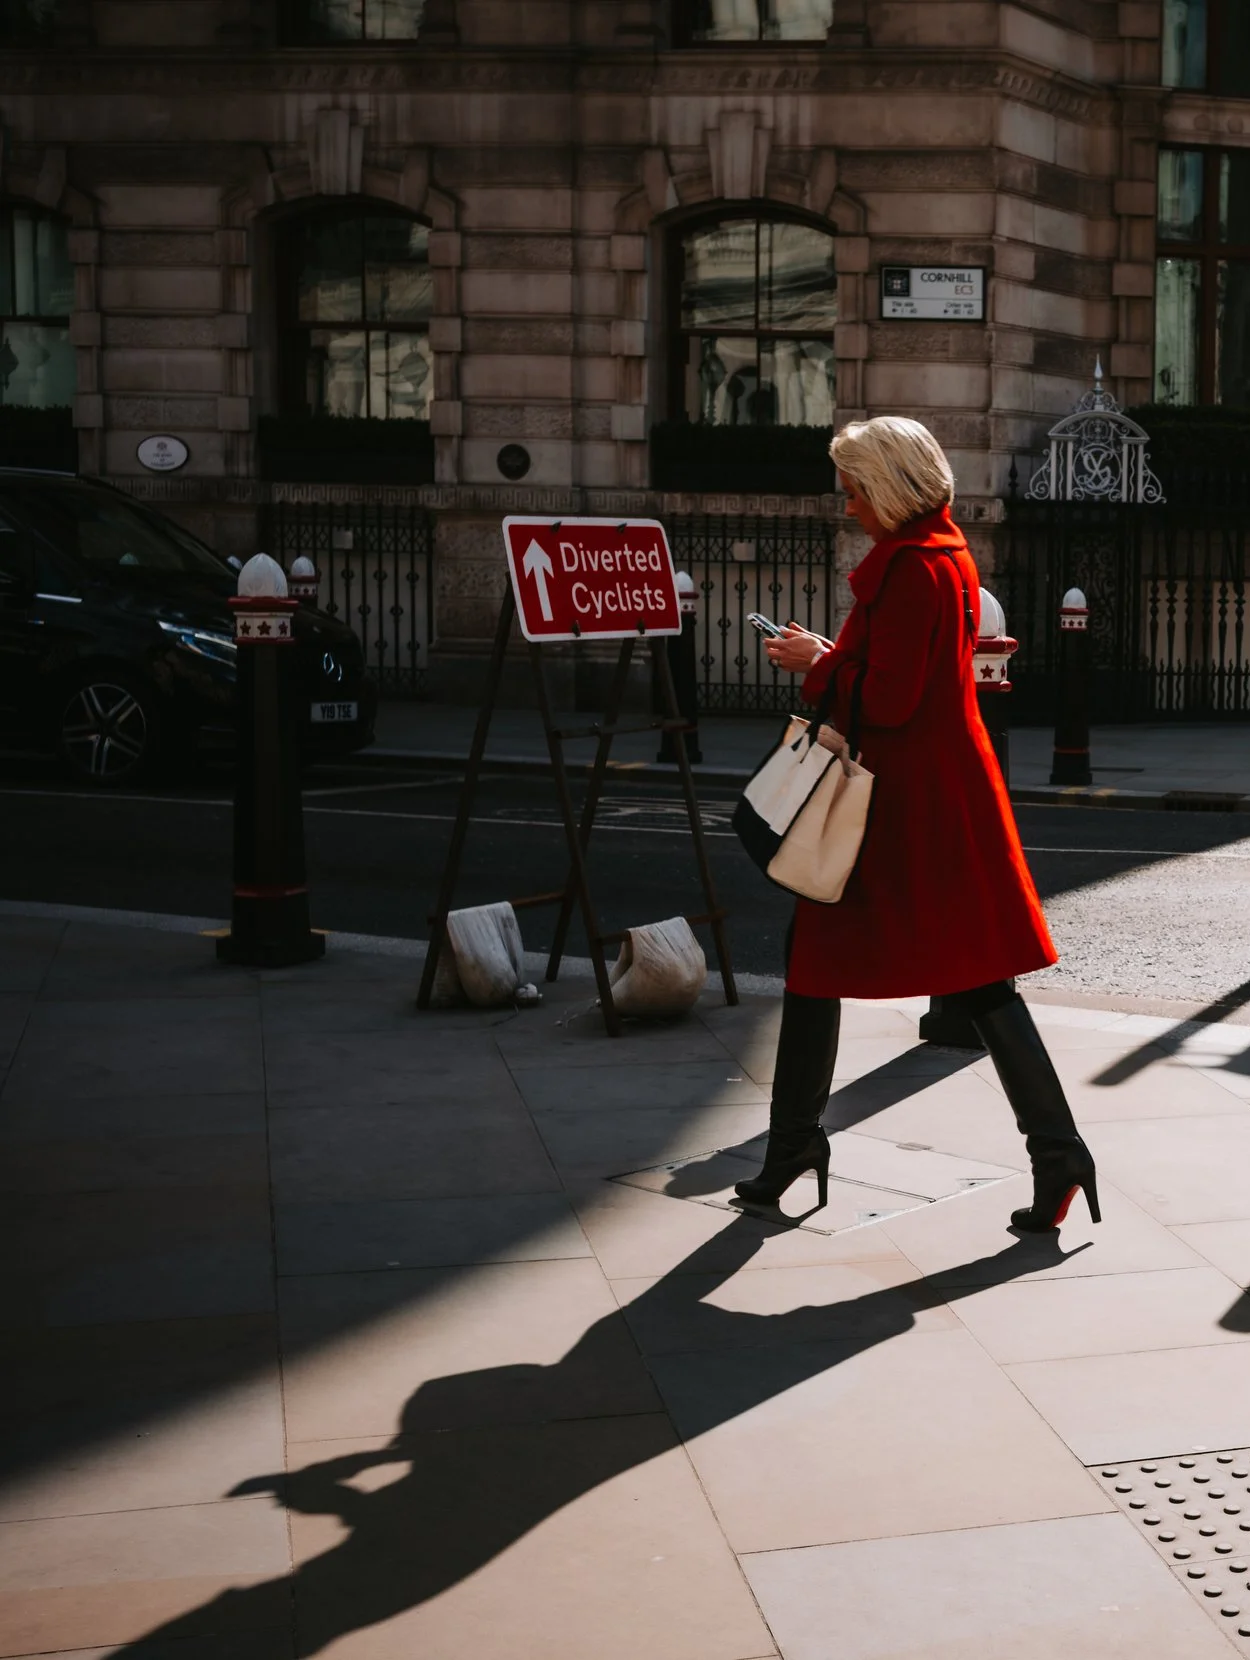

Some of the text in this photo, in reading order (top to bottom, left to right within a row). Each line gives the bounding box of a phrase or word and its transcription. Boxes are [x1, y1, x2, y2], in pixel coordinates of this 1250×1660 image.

[920, 272, 974, 283] CORNHILL
[954, 285, 974, 295] EC3
[558, 542, 662, 573] Diverted
[571, 581, 666, 619] Cyclists
